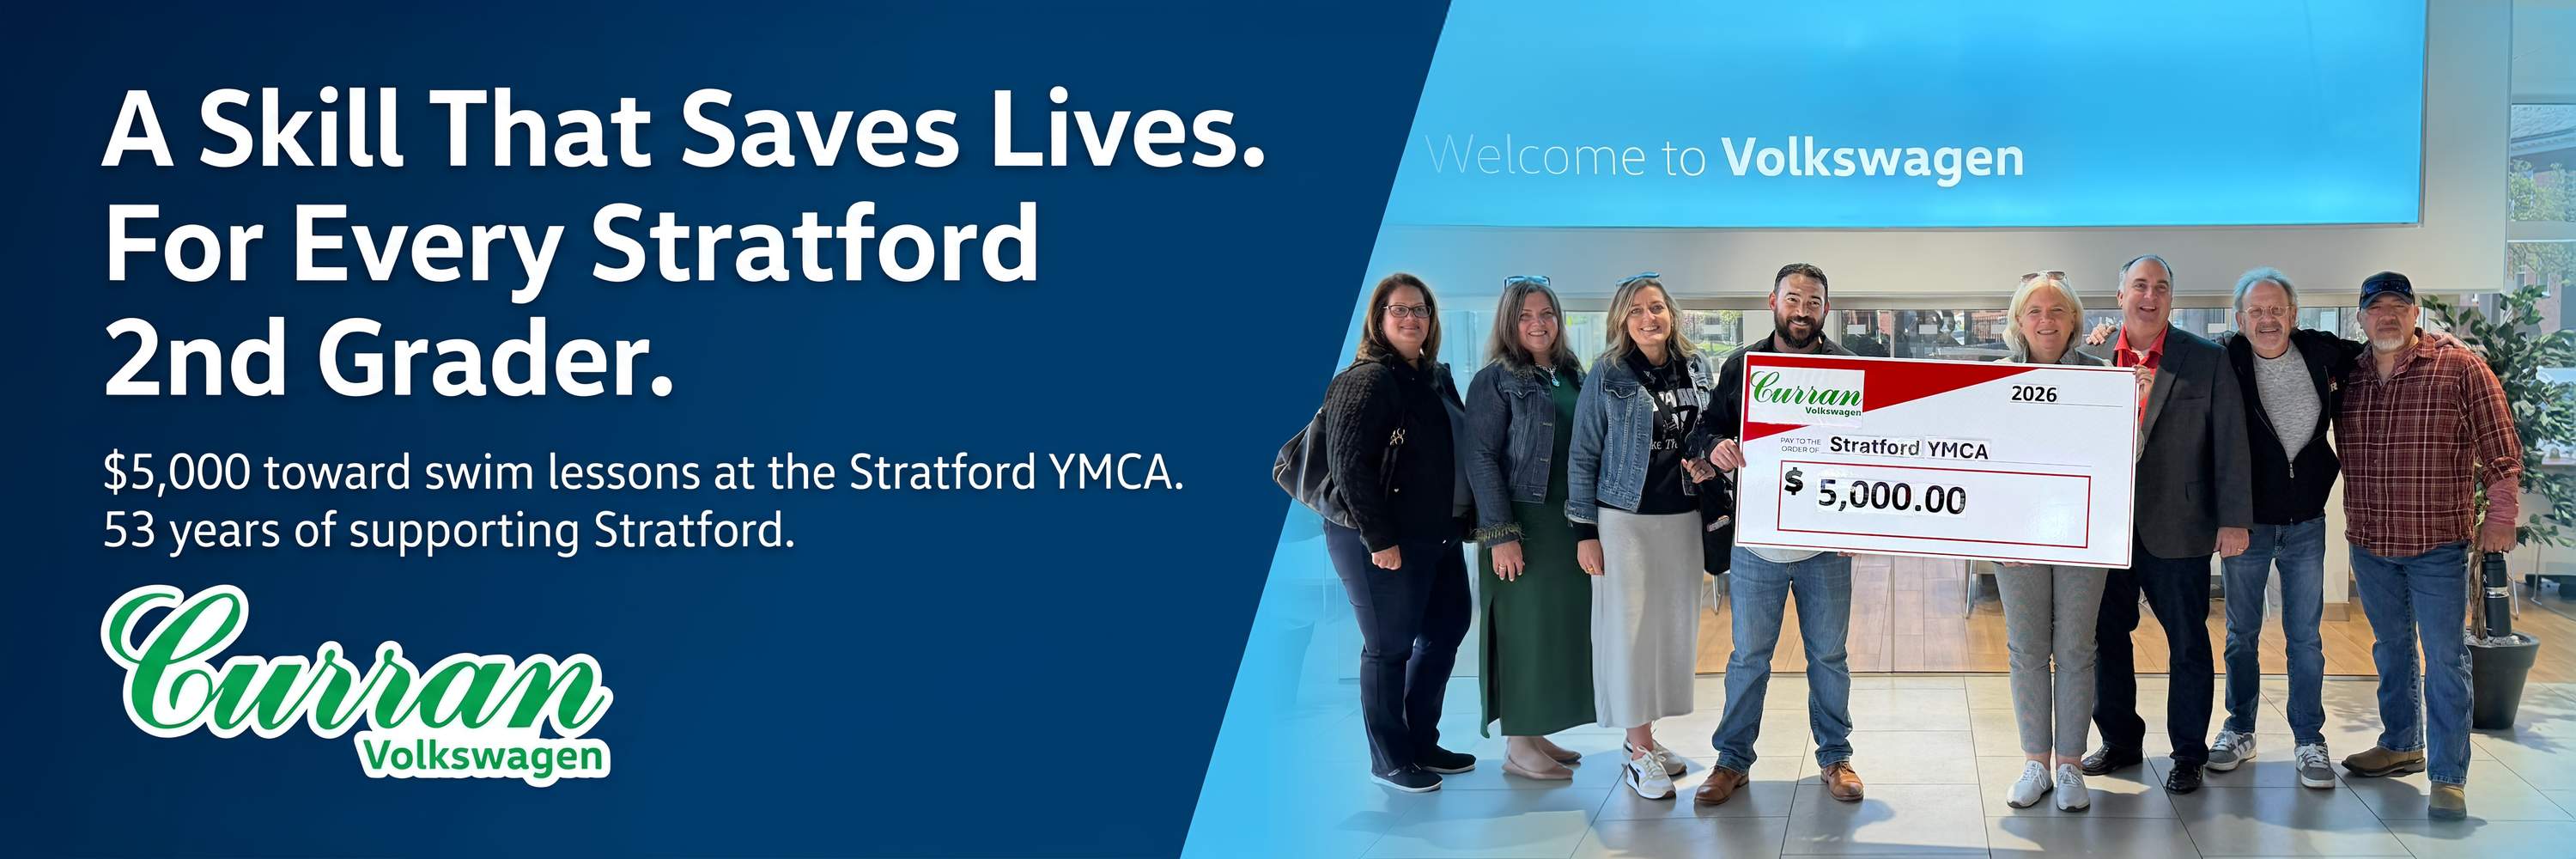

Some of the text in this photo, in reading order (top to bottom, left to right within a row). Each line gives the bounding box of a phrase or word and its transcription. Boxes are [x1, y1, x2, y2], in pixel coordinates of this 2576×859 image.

[1425, 133, 2024, 187] Welcome to Volkswagen
[1750, 370, 1862, 406] Curran
[2012, 385, 2057, 403] 2026
[1805, 406, 1862, 417] Volkswagen
[1830, 436, 1989, 460] Stratford YMCA
[1783, 466, 1967, 515] $ 5,000.00
